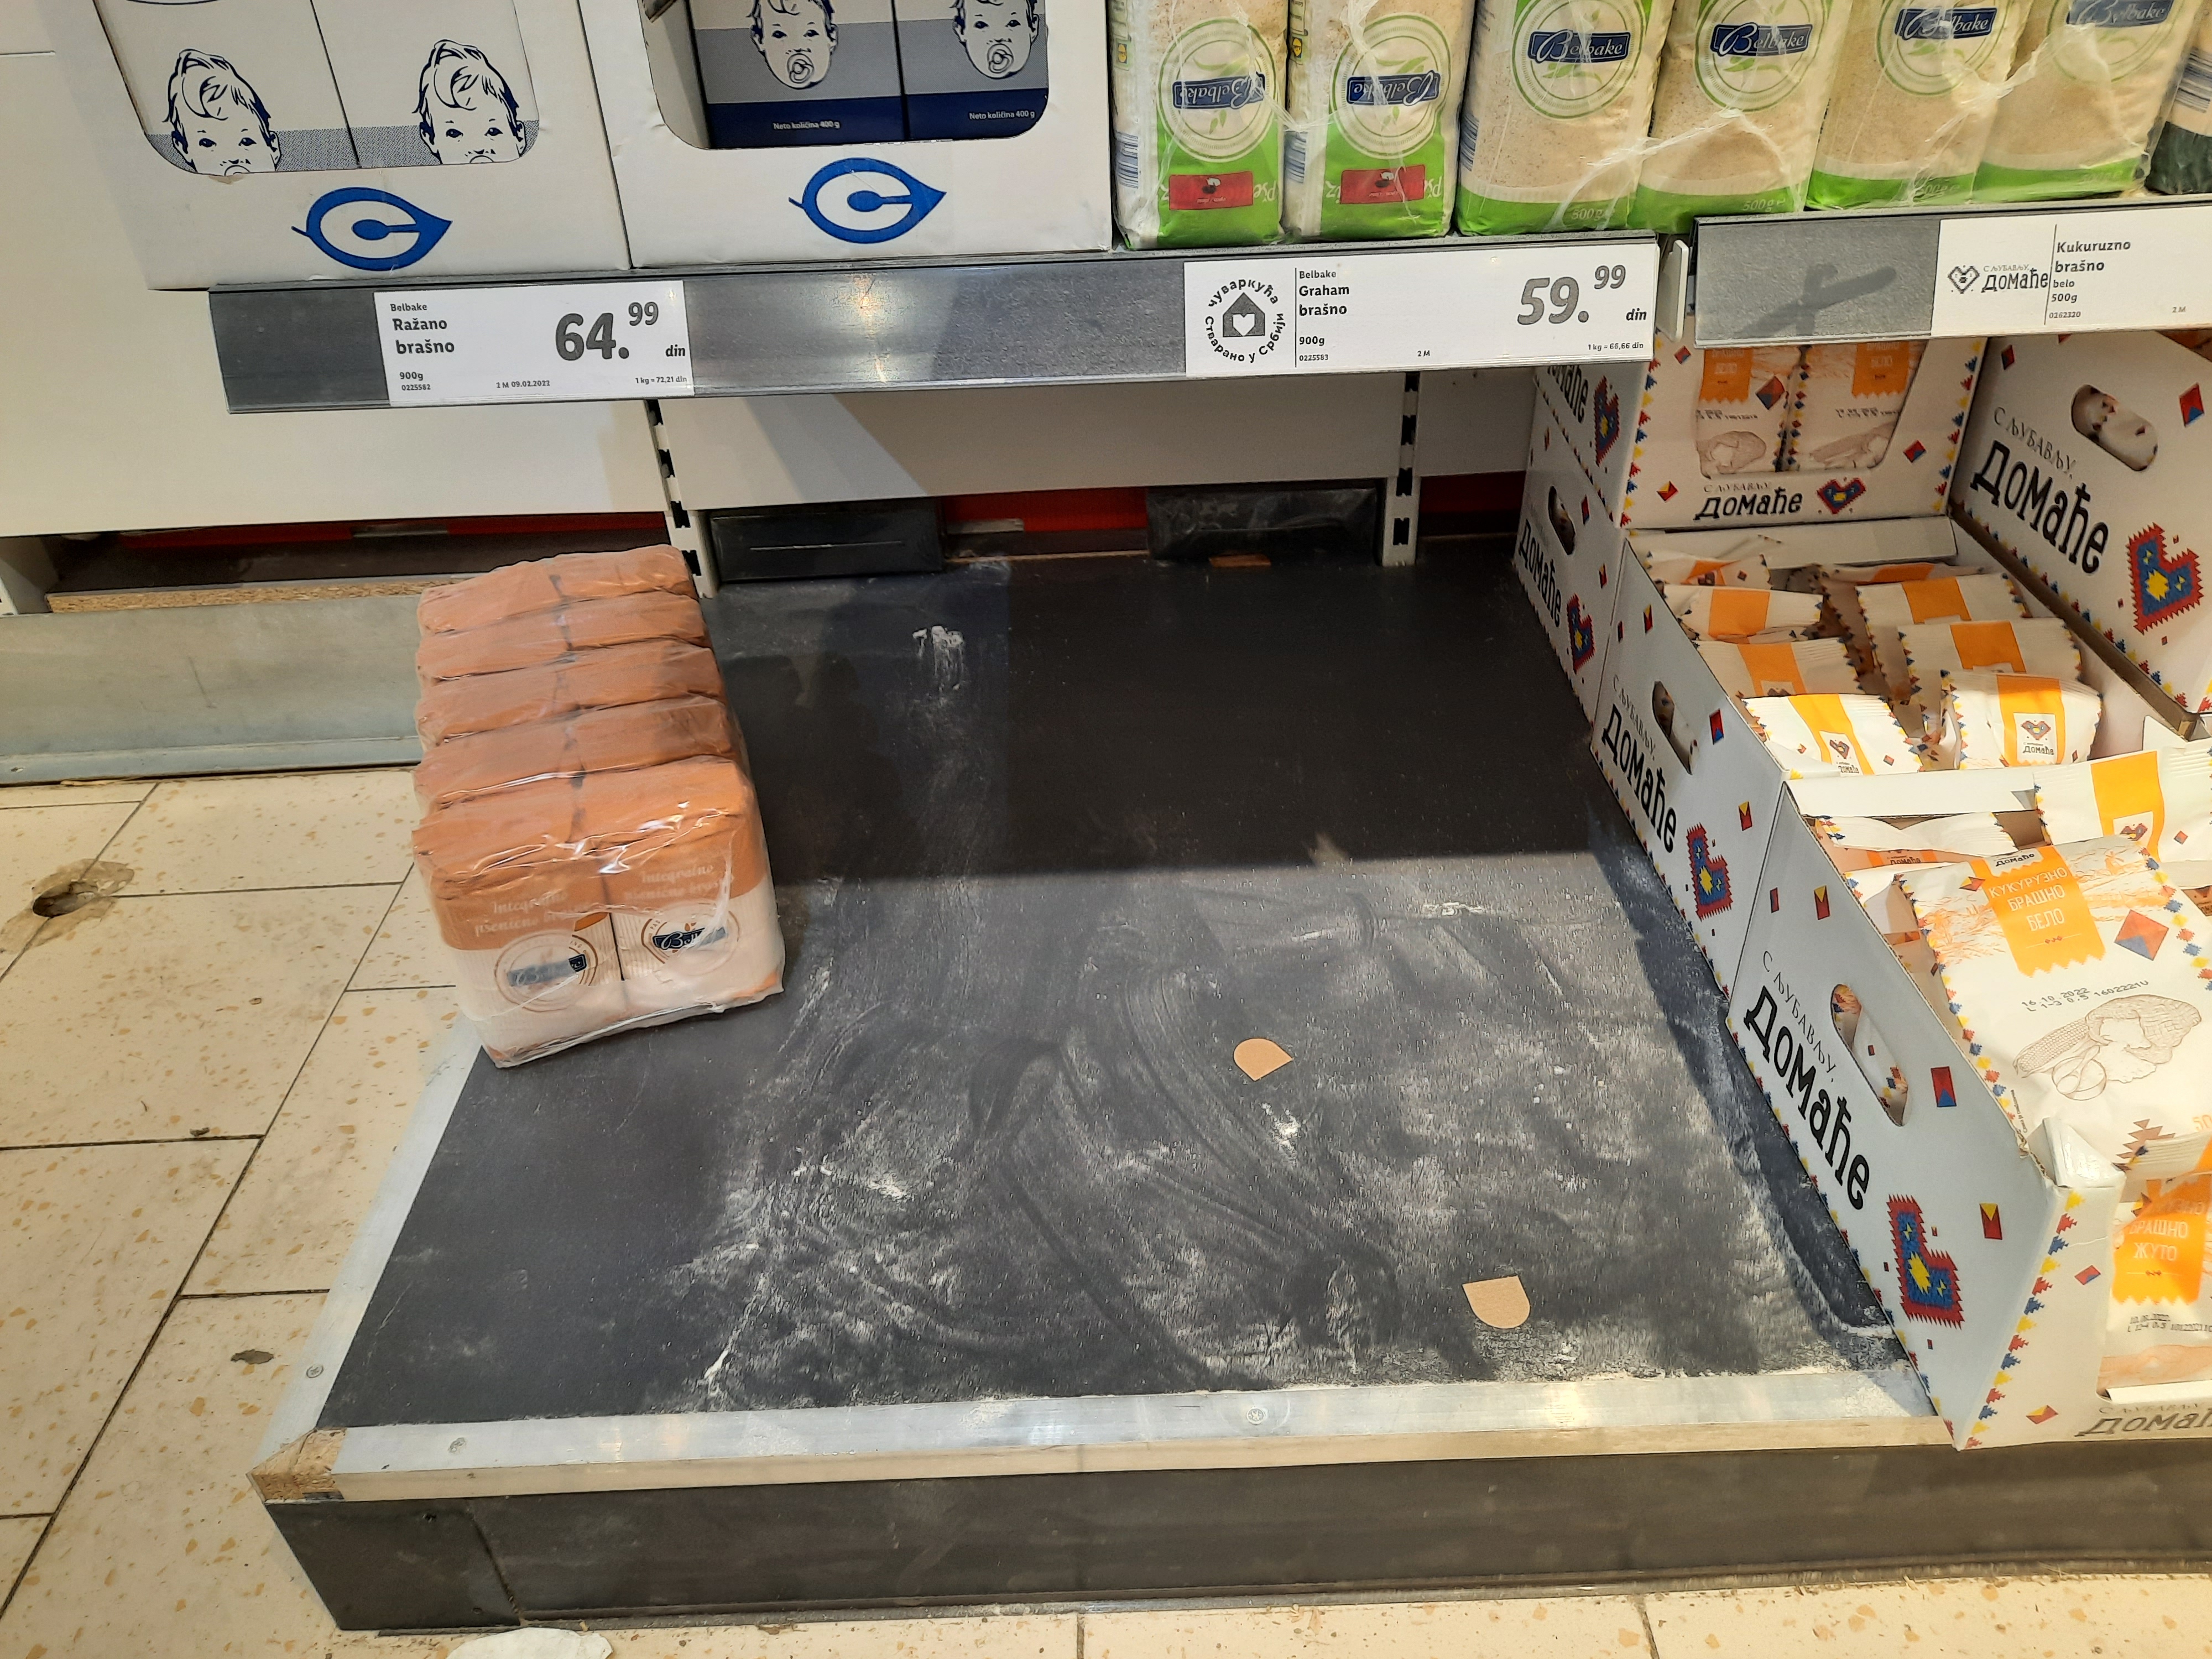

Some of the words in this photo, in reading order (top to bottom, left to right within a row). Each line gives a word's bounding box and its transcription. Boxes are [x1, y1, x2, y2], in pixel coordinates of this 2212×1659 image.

[2057, 240, 2131, 253] Kukuruzno
[2054, 259, 2105, 273] brašno
[1299, 270, 1337, 279] Belbake
[1299, 284, 1350, 296] Graham
[2053, 279, 2075, 288] belo
[2052, 293, 2078, 304] 500g
[390, 302, 428, 312] Belbake
[1299, 303, 1348, 316] brašno
[1626, 307, 1647, 321] din
[392, 317, 447, 331] Ražano
[1205, 316, 1245, 362] Стварано
[1249, 352, 1256, 363] у
[1259, 313, 1286, 356] Србији
[1299, 336, 1325, 346] 900g
[395, 338, 455, 354] brašno
[665, 344, 686, 357] din
[1593, 343, 1602, 352] kg
[399, 371, 424, 381] 900g
[1988, 867, 2068, 899] КУКУРУЗНО
[2007, 884, 2065, 912] БРАШНО
[2026, 907, 2065, 932] БЕЛО
[2129, 1219, 2189, 1239] БРАШНО
[2133, 1242, 2178, 1261] ЖУТО
